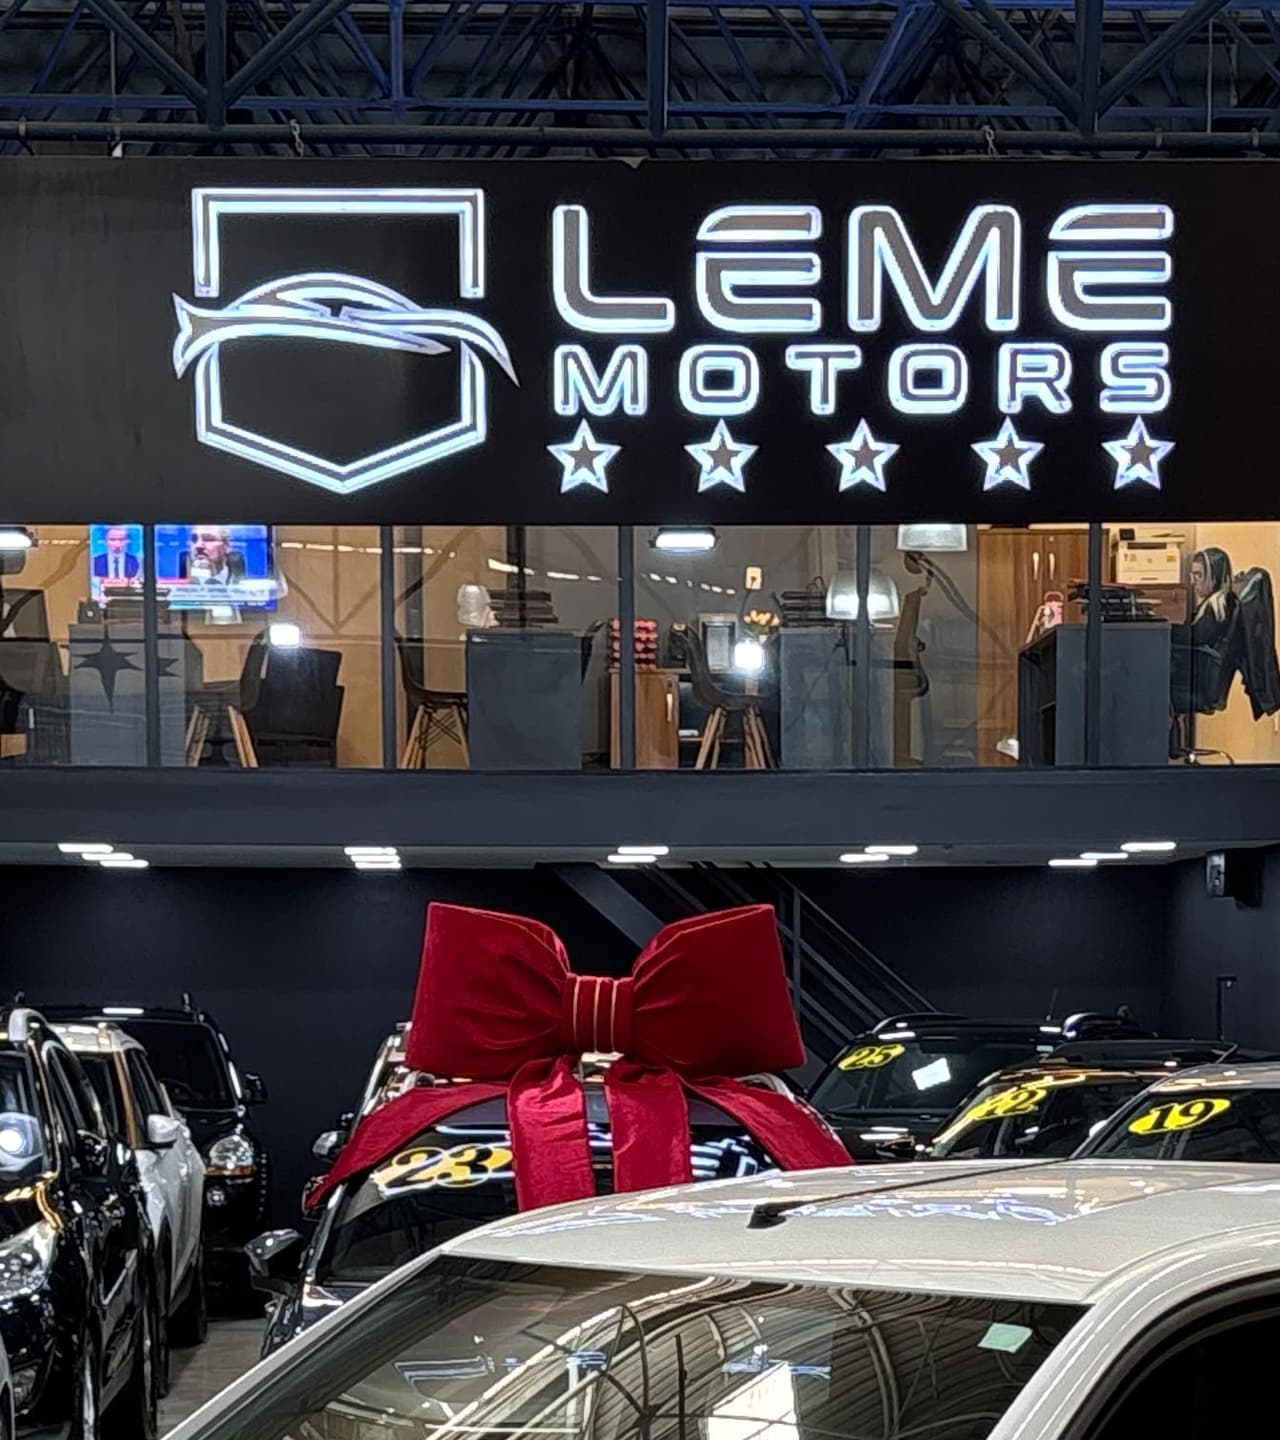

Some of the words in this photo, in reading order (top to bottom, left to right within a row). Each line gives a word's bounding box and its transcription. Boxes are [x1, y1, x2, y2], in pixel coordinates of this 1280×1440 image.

[551, 203, 1176, 333] LEME
[552, 343, 1175, 415] MOTORS
[843, 1043, 901, 1070] 25
[1146, 1099, 1219, 1134] 19
[380, 1144, 496, 1198] 23
